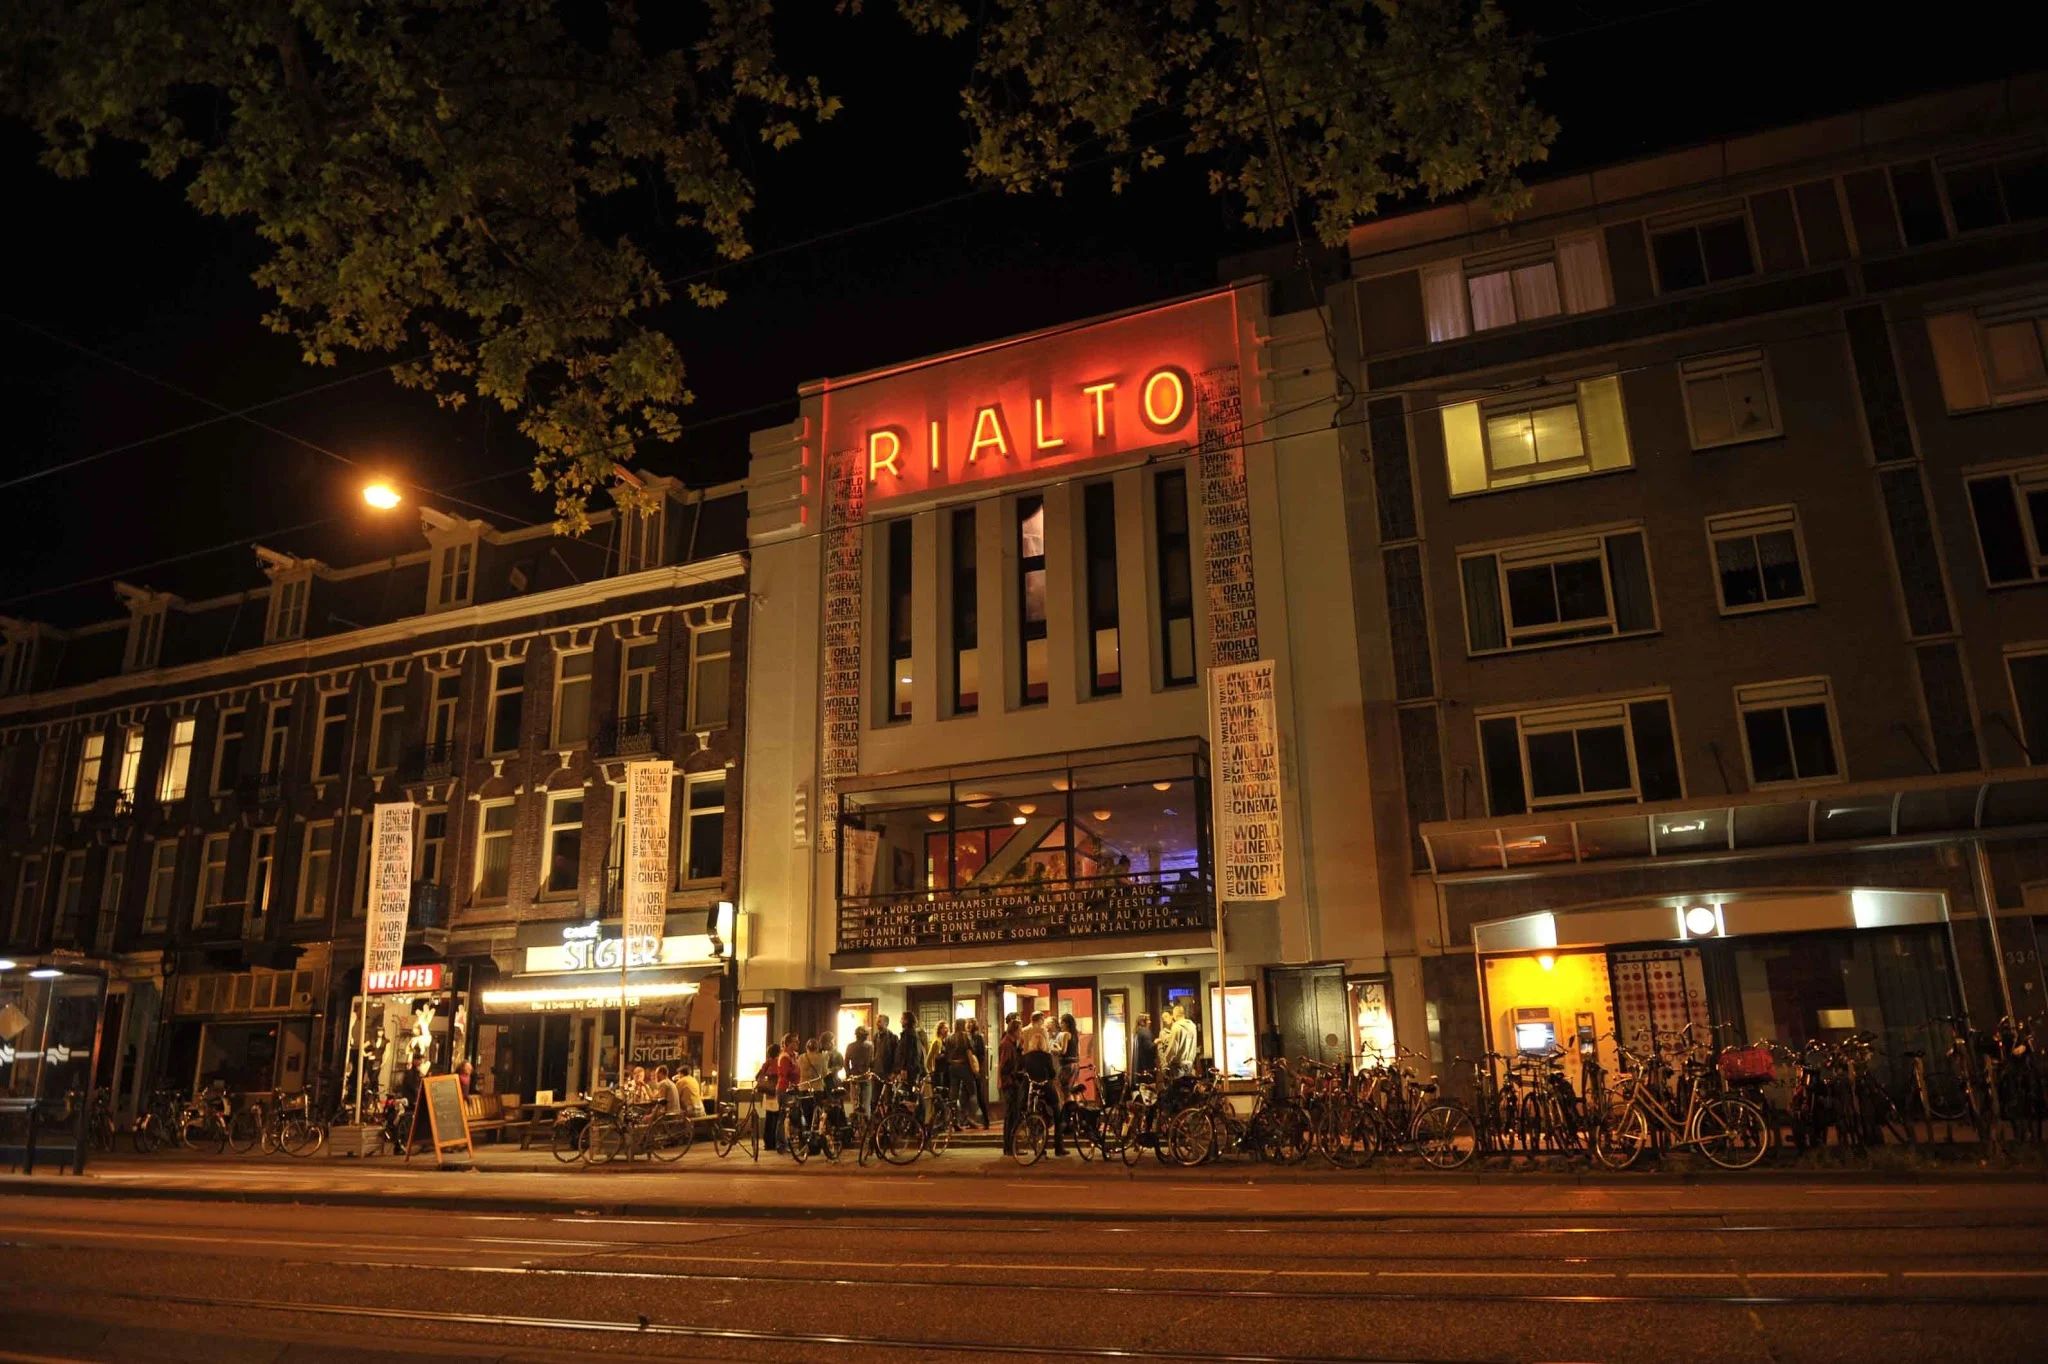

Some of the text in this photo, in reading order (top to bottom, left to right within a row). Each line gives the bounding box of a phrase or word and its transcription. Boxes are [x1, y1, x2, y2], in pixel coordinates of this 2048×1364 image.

[870, 371, 1184, 484] RIALTO
[1209, 512, 1249, 527] CINEMA
[1222, 581, 1254, 596] ORLD
[832, 645, 860, 658] ORLD
[1216, 637, 1258, 652] WORLD
[1216, 648, 1258, 663] CINEMA
[1226, 679, 1271, 695] CINEMA
[824, 696, 859, 709] WORLD
[1227, 691, 1273, 704] AMSTERDAM
[831, 721, 859, 734] ORLD
[1220, 706, 1229, 744] FESTIVAL
[1232, 760, 1276, 775] CINEMA
[1232, 784, 1278, 799] WORLD
[1232, 798, 1279, 815] CINEMA
[1233, 823, 1280, 841] WORLD
[1233, 839, 1282, 856] CINEMA
[1234, 853, 1281, 865] AMSTERDAM
[380, 903, 406, 914] CINEM
[863, 885, 1162, 917] WWW.WORLDCINEMAAMSTERDAM.NL 10 T/M 21 AUG.
[877, 915, 916, 926] FILMS,
[933, 909, 1011, 923] REGISSEURS,
[1026, 905, 1057, 917] OPEN
[1063, 902, 1092, 914] AIR,
[862, 927, 903, 939] GIANNI
[923, 924, 937, 934] LE
[942, 921, 978, 933] DONNE
[1050, 914, 1065, 925] LE
[1070, 911, 1110, 924] GAMIN
[1116, 909, 1132, 920] AU
[1138, 906, 1171, 918] VELO
[849, 935, 918, 949] SEPARATION
[941, 933, 956, 944] IL
[960, 929, 1006, 942] GRANDE
[1010, 926, 1048, 939] SOGNO
[1069, 916, 1203, 935] WWW.RIALTOFILM.NL
[562, 937, 660, 970] STIGTER
[369, 968, 433, 990] UNZIPPED
